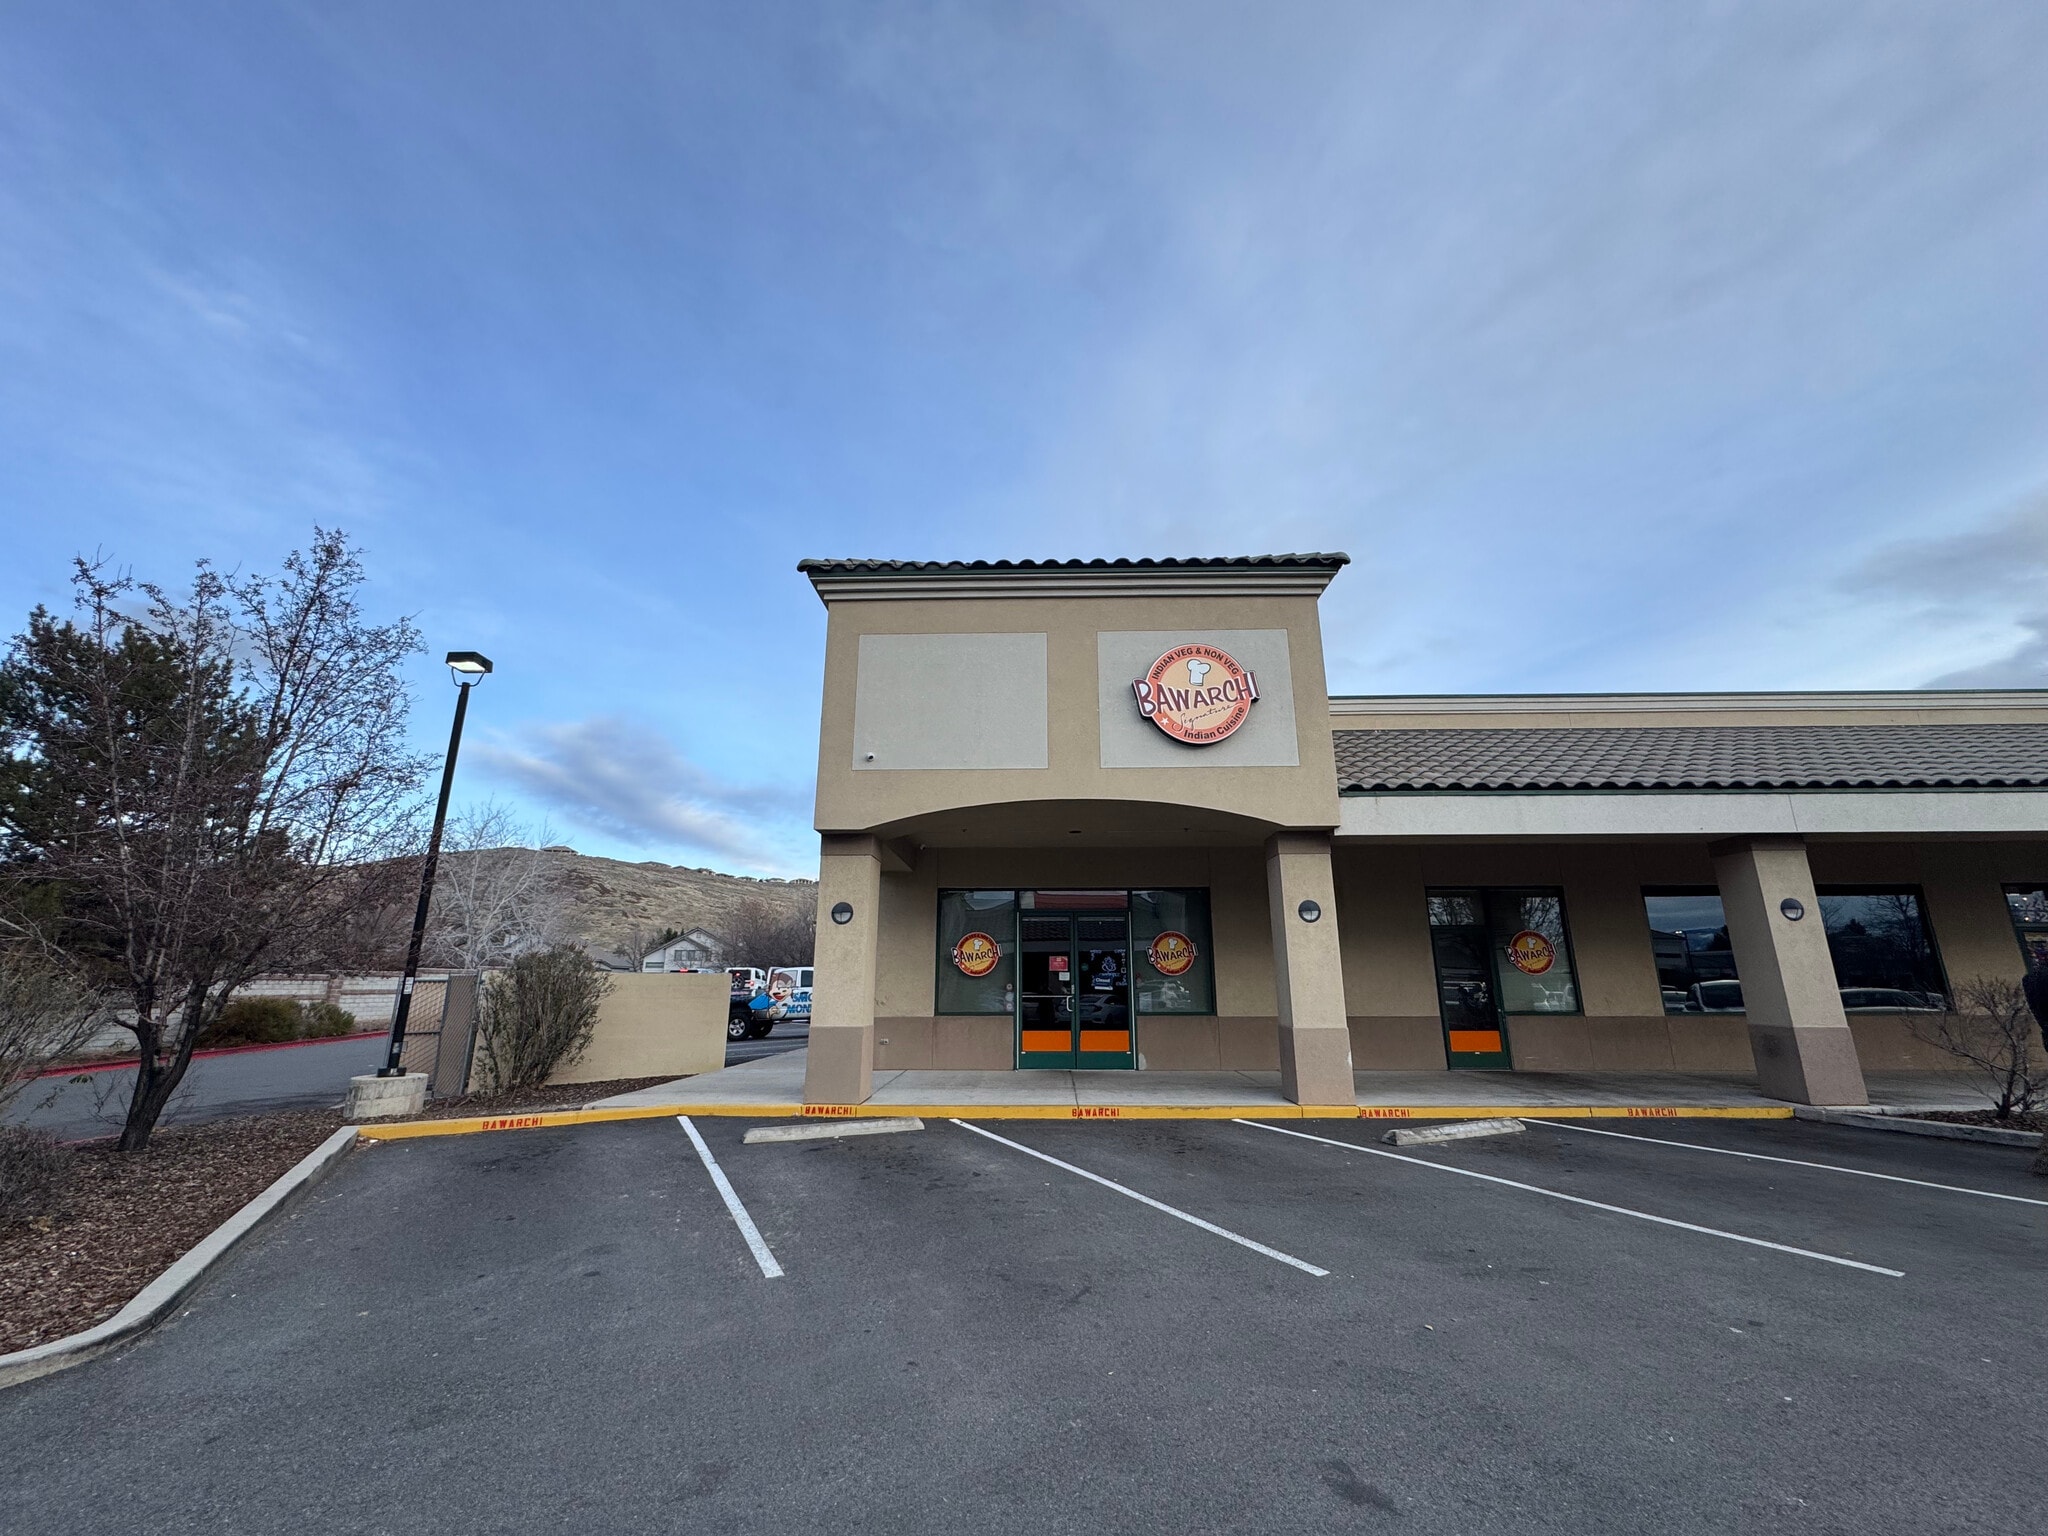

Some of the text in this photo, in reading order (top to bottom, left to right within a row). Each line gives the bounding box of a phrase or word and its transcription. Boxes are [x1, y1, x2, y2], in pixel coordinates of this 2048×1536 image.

[1151, 647, 1240, 680] INDIAN VEG & NON VEG
[1133, 670, 1261, 717] BAWARCHI
[1172, 702, 1243, 732] Signature
[1183, 706, 1245, 740] Indian Cuisine
[952, 943, 1002, 965] BAWARCHI
[1146, 943, 1198, 964] BAWARCHI
[1504, 943, 1558, 963] BAWARCHI
[805, 1106, 852, 1114] BAWARCHI
[1072, 1108, 1120, 1117] BAWARCHI
[1361, 1109, 1410, 1118] BAWARCHI
[1627, 1108, 1678, 1116] BAWARCHI
[482, 1117, 543, 1130] BAWARCHI
